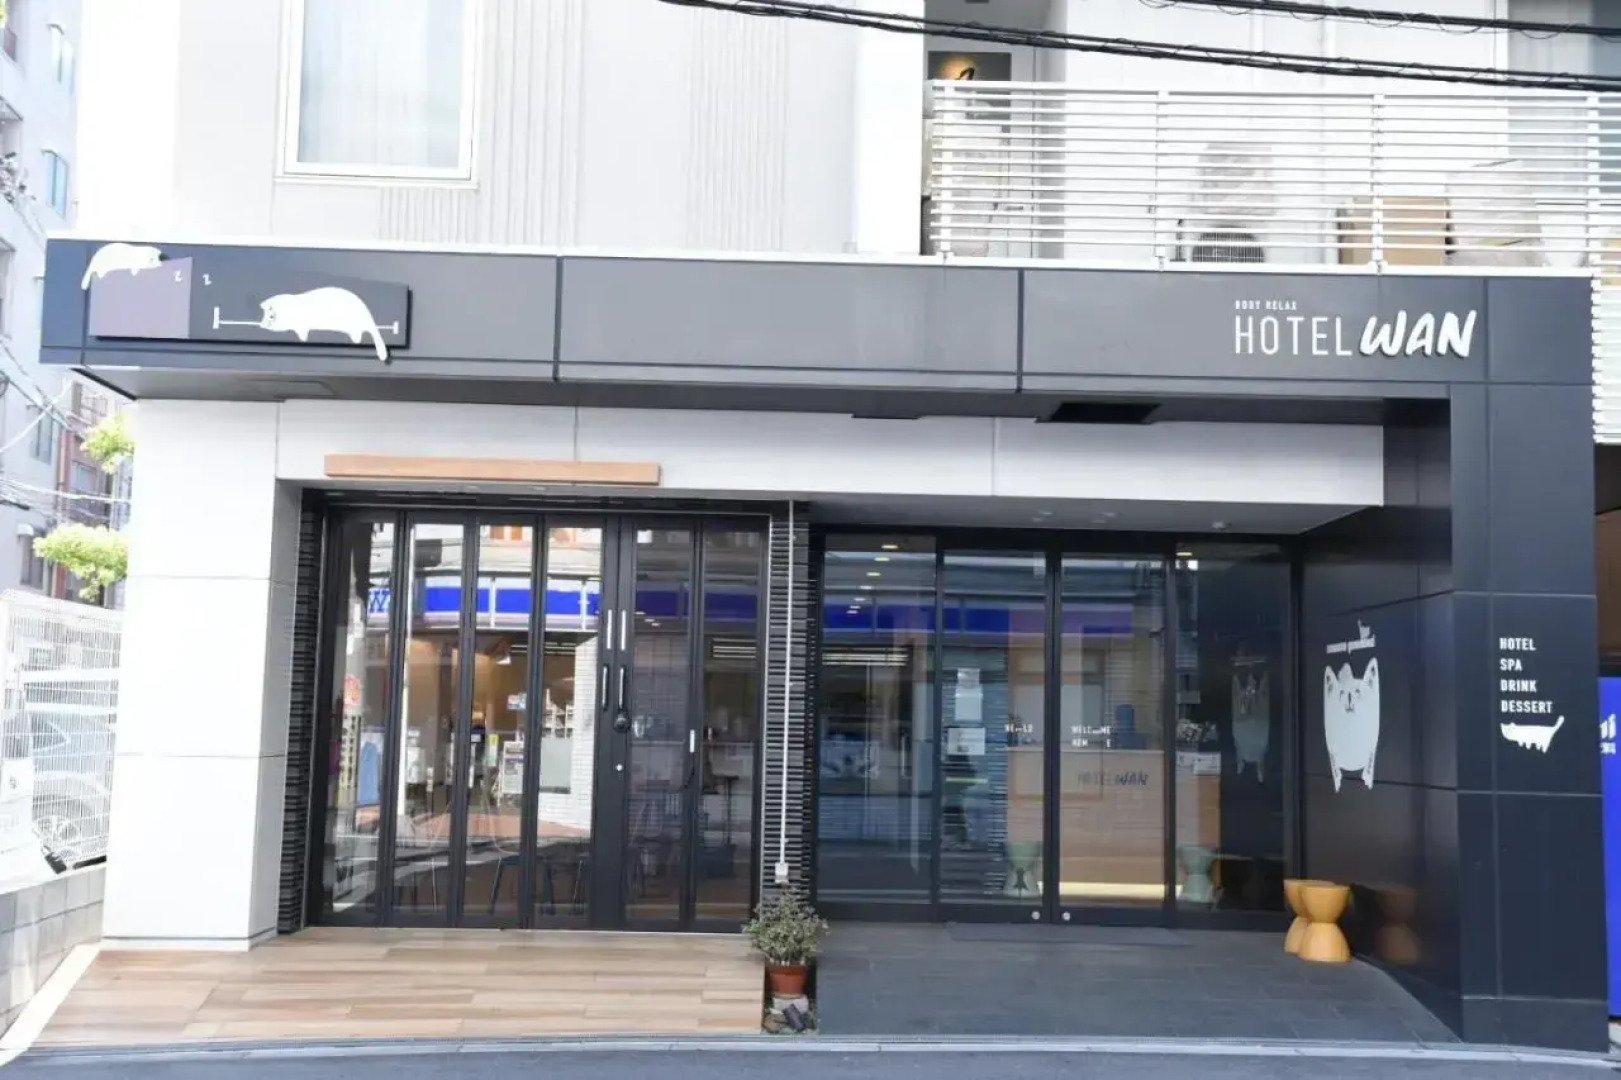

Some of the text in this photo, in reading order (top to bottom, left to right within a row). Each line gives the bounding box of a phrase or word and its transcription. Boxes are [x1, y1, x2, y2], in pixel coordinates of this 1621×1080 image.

[1265, 299, 1297, 311] RELAX
[1235, 309, 1477, 358] HOTEL WAN
[1500, 637, 1536, 650] HOTEL
[1499, 658, 1522, 671] SPA
[1500, 679, 1537, 692] DRINK
[1501, 700, 1553, 713] DESSERT
